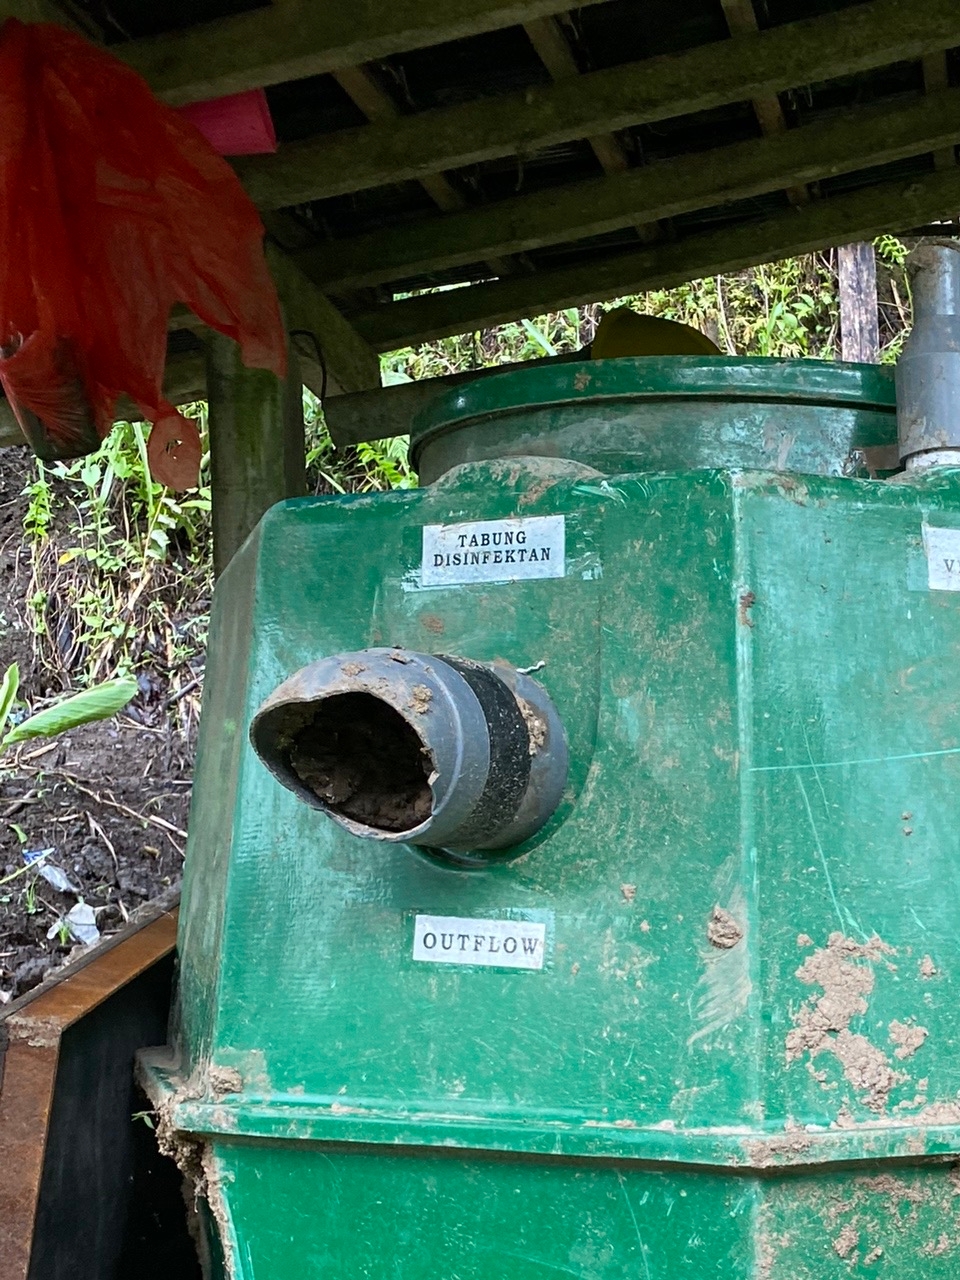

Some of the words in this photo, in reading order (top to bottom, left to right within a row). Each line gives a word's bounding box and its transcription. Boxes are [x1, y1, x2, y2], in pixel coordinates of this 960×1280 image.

[458, 531, 527, 547] TABUNG
[433, 547, 551, 567] DISINFEKTAN
[423, 932, 539, 955] OUTFLOW
